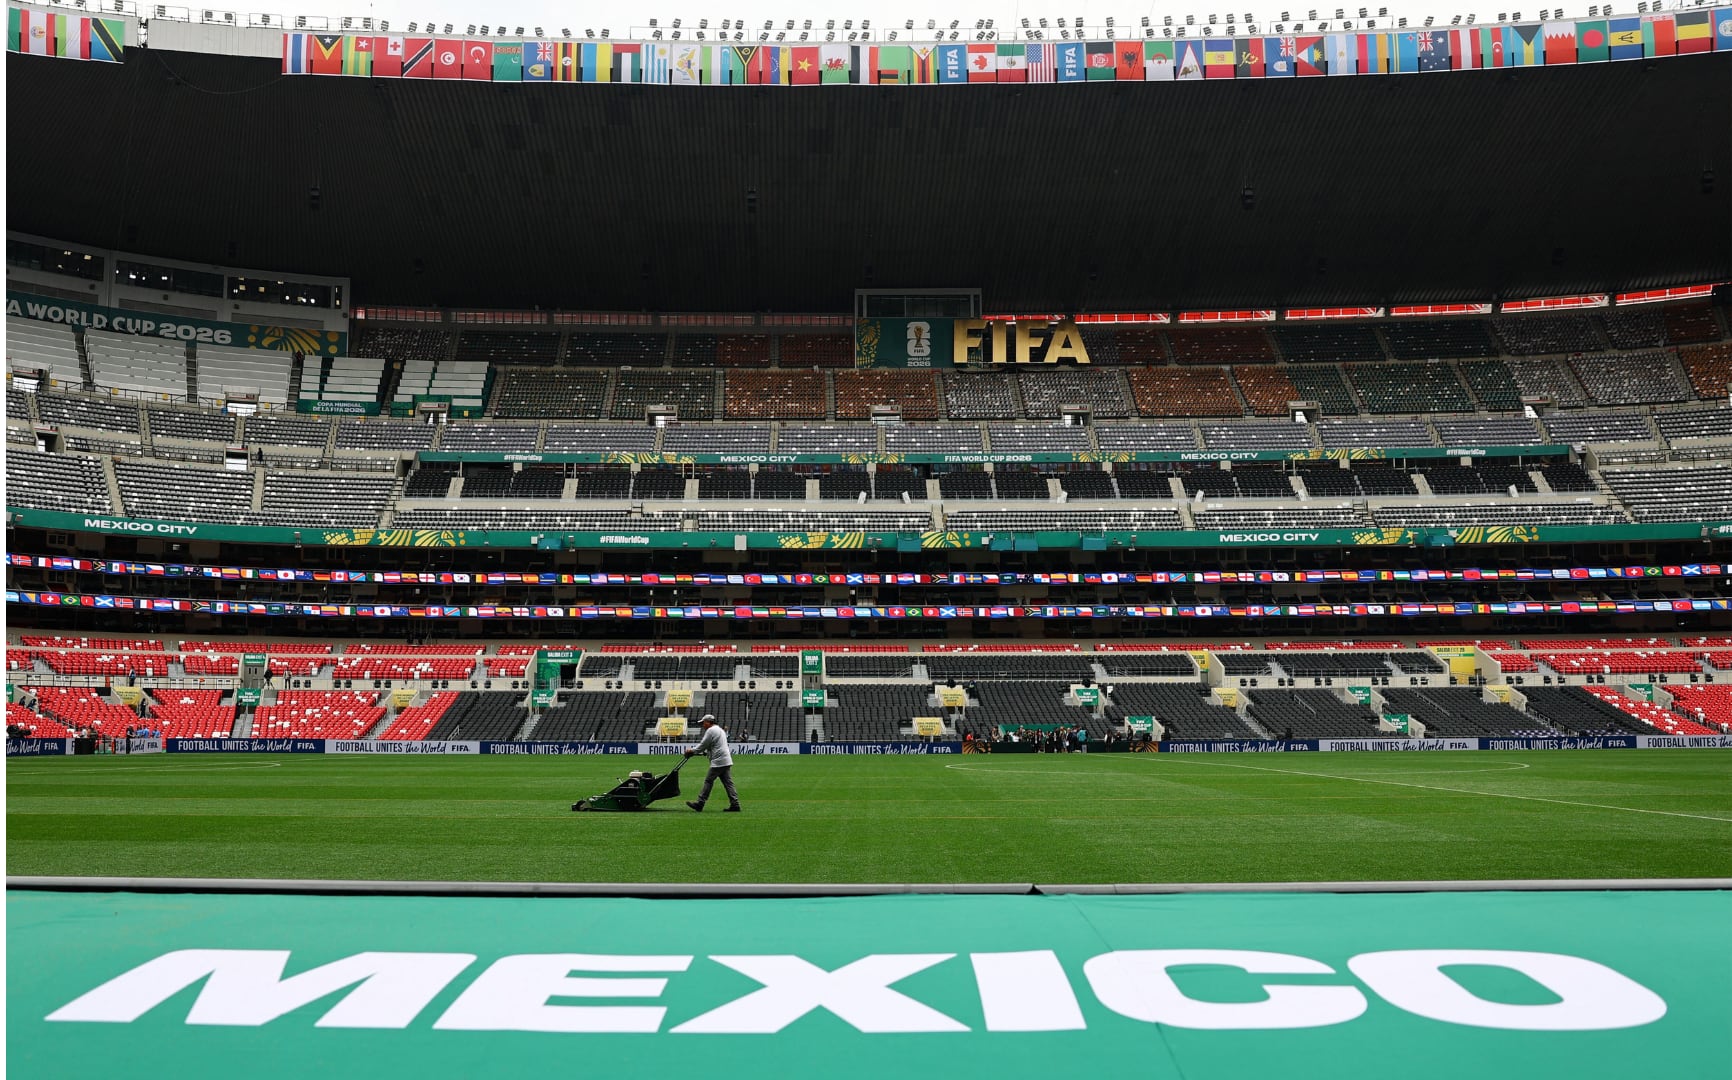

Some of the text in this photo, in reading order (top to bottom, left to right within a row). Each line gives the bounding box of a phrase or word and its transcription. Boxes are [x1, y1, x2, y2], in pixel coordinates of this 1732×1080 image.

[947, 49, 958, 78] FIFA
[1066, 47, 1077, 77] FIFA
[6, 299, 232, 344] A WORLD CUP 2026
[953, 319, 1091, 364] FIFA
[84, 519, 198, 535] MEXICO CITY
[600, 535, 650, 545] #FIFAWorldCup
[1220, 533, 1319, 542] MEXICO CITY
[6, 740, 19, 755] the
[20, 740, 41, 755] World
[44, 742, 59, 751] FIFA
[178, 739, 315, 752] FOOTBALL UNITES the World FIFA
[336, 742, 373, 752] FOOTBALL
[376, 742, 402, 752] UNITES
[404, 741, 419, 753] the
[420, 741, 447, 754] World
[490, 744, 529, 754] FOOTBALL
[532, 744, 559, 754] UNITES
[560, 743, 576, 754] the
[577, 743, 605, 754] World
[811, 743, 952, 754] FOOTBALL UNITES the World FIFA
[1169, 741, 1309, 753] FOOTBALL UNITES the World FIFA
[1331, 741, 1369, 752] FOOTBALL
[1372, 741, 1400, 752] UNITES
[1401, 740, 1417, 751] the
[1418, 740, 1445, 751] World
[1489, 740, 1529, 750] FOOTBALL
[1531, 740, 1559, 750] UNITES
[1559, 738, 1576, 750] the
[1577, 737, 1604, 750] World
[1648, 737, 1686, 748] FOOTBALL
[1688, 737, 1717, 748] UNITES
[45, 948, 1668, 1034] MEXICO
